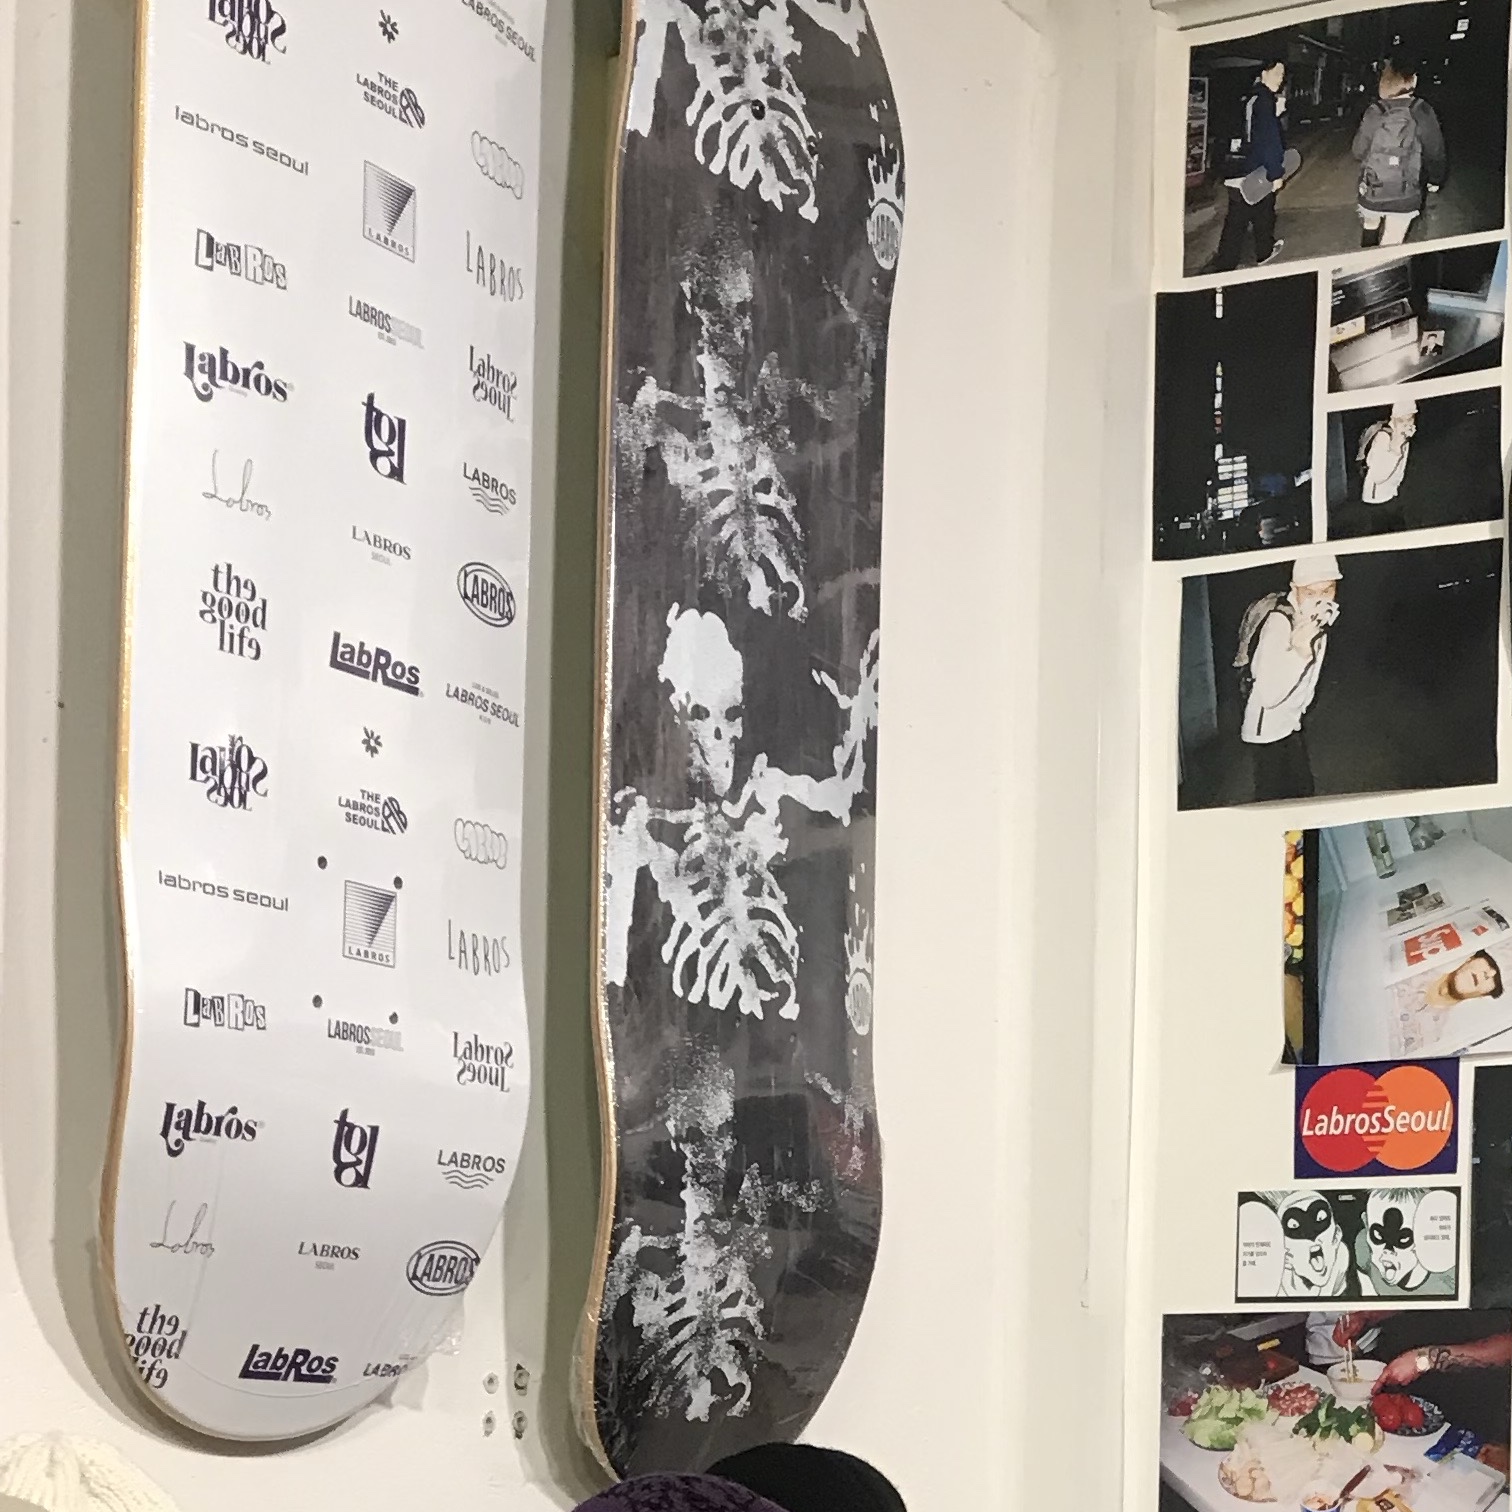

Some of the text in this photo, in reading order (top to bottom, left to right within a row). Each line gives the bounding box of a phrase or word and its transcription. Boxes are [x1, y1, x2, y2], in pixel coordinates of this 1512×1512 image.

[506, 26, 536, 62] SEOUL
[356, 73, 398, 106] LABROS
[377, 71, 399, 92] THE
[364, 91, 398, 119] SEOUL
[465, 230, 524, 302] LABROS
[348, 295, 392, 333] LABROS
[463, 462, 518, 506] LABROS
[351, 525, 412, 561] LABROS
[199, 590, 268, 631] good
[463, 569, 515, 621] LABROS
[445, 683, 489, 713] LABROS
[489, 702, 520, 728] SEOUL
[338, 796, 381, 818] LABROS
[360, 788, 381, 804] THE
[345, 811, 382, 832] SEOUL
[348, 946, 391, 964] LABROS
[448, 919, 511, 977] LABROS
[328, 1018, 372, 1045] LABROS
[437, 1149, 507, 1174] LABROS
[297, 1241, 361, 1261] LABROS
[412, 1242, 480, 1286] LABROS
